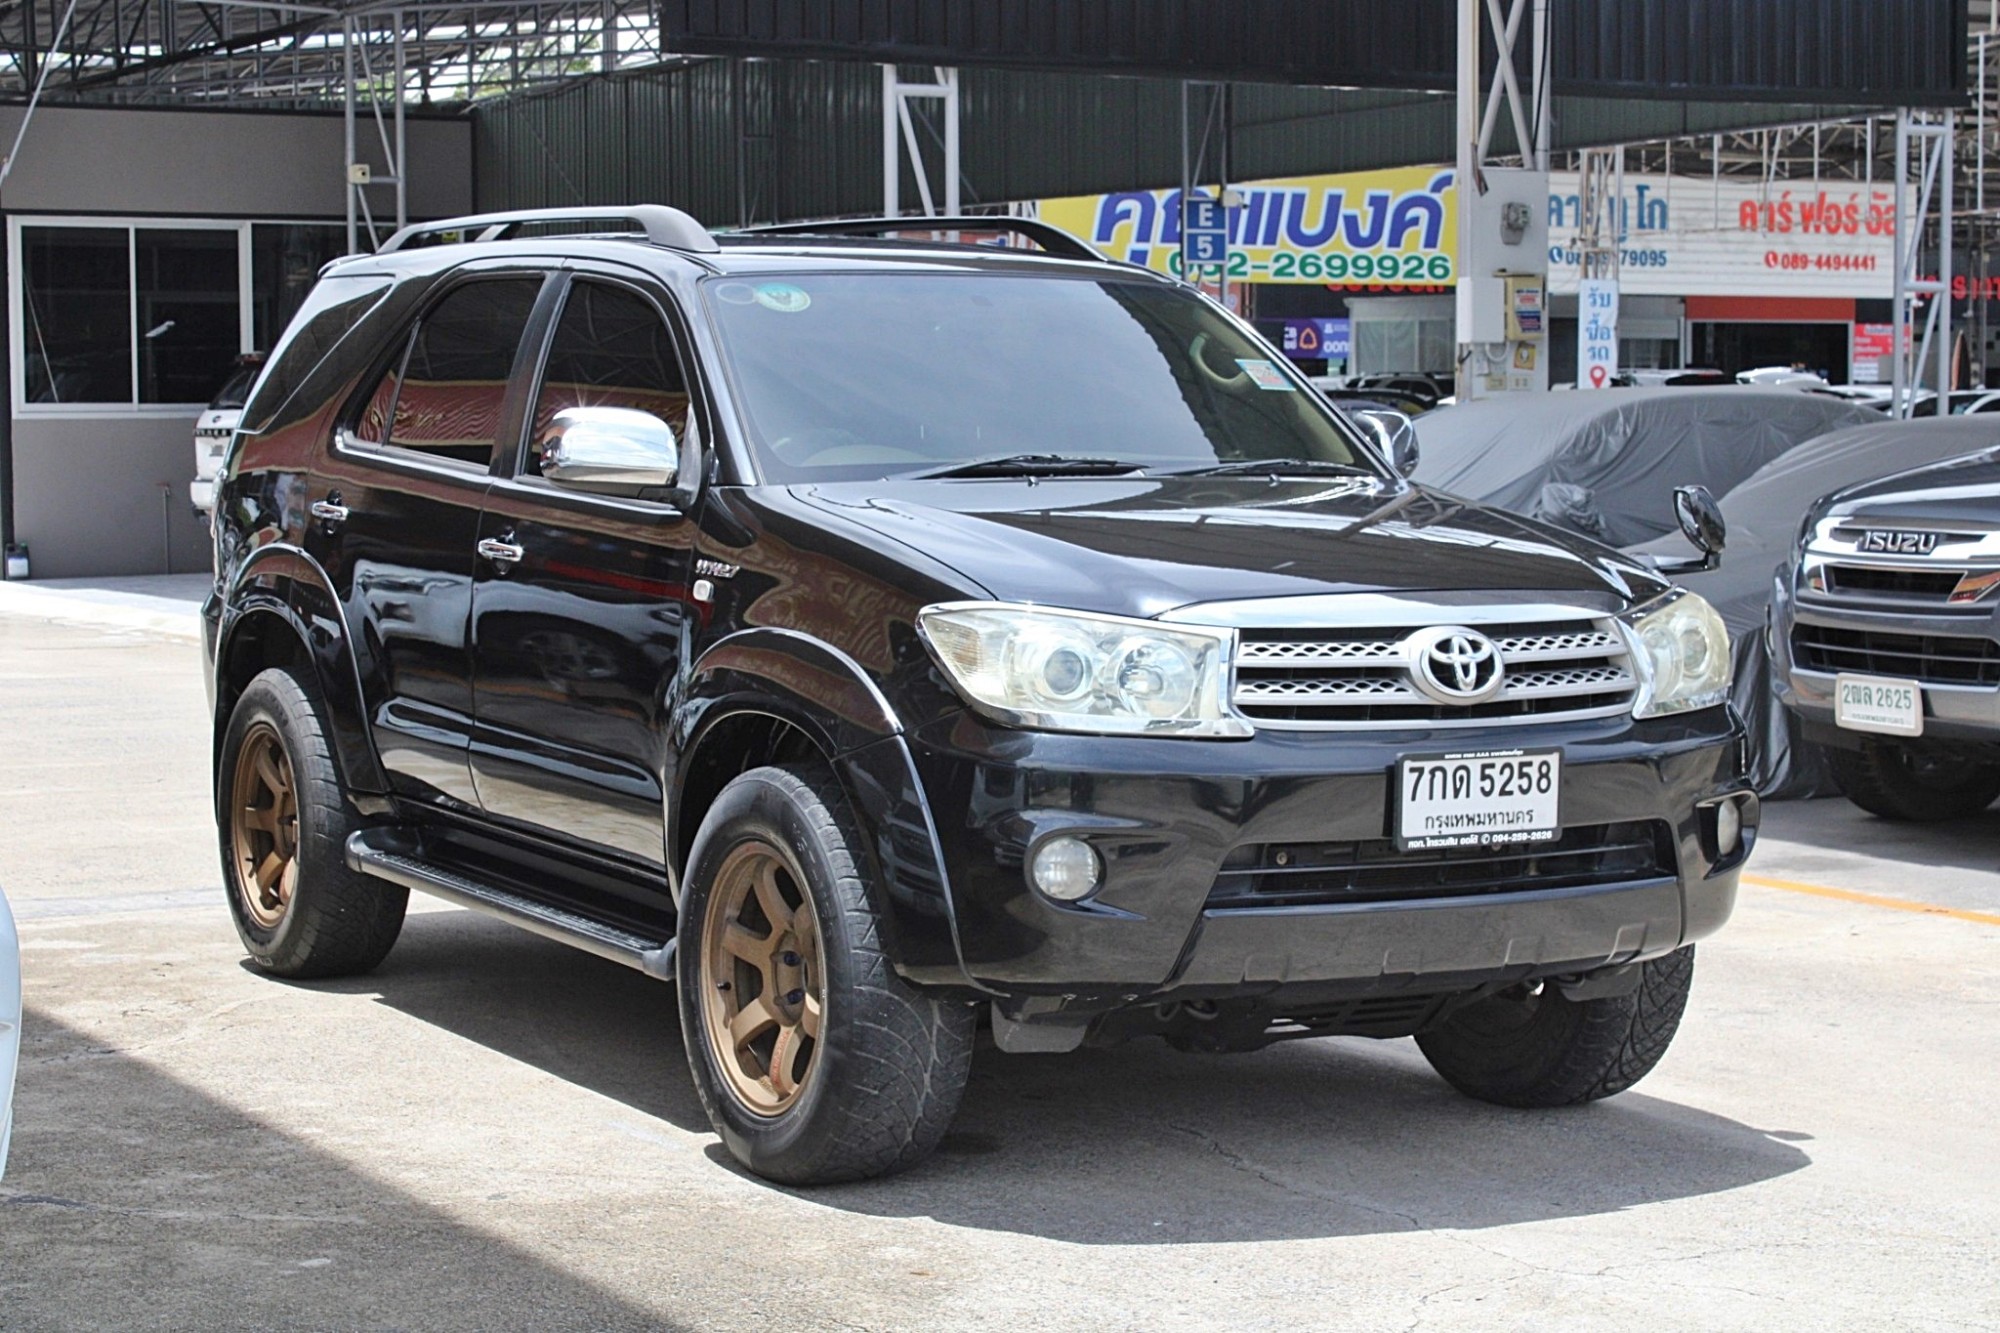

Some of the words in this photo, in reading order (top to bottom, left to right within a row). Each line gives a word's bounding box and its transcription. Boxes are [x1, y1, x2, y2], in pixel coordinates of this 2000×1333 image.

[1199, 203, 1214, 227] E
[1636, 184, 1668, 230] โก
[1739, 190, 1793, 233] คาร์
[1800, 191, 1859, 235] ฟอร์
[1197, 235, 1213, 259] 5
[1780, 253, 1876, 271] 089-4494441
[1864, 531, 1936, 552] ISUZU
[1876, 687, 1912, 710] 2625
[1408, 764, 1471, 802] 7กด
[1479, 760, 1552, 797] 5258
[1425, 809, 1535, 835] กรุงเทพมหานคร
